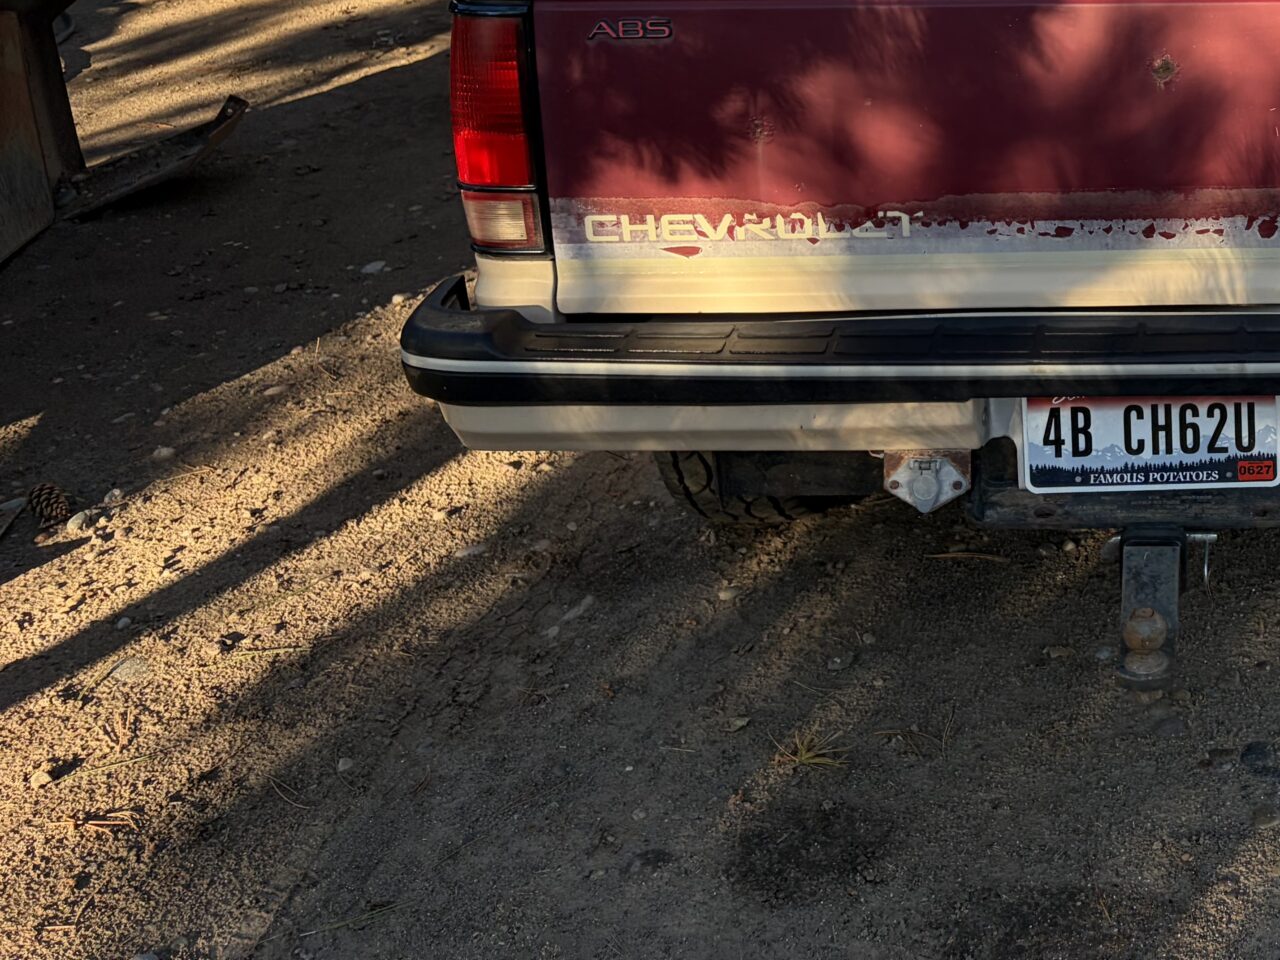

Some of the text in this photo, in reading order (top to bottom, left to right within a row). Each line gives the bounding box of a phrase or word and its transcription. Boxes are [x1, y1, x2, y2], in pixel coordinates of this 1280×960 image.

[587, 19, 672, 40] ABS
[1042, 401, 1256, 458] 4B CH62U
[1089, 469, 1219, 485] FAMOUS POTATOES
[1238, 464, 1273, 476] 0627
